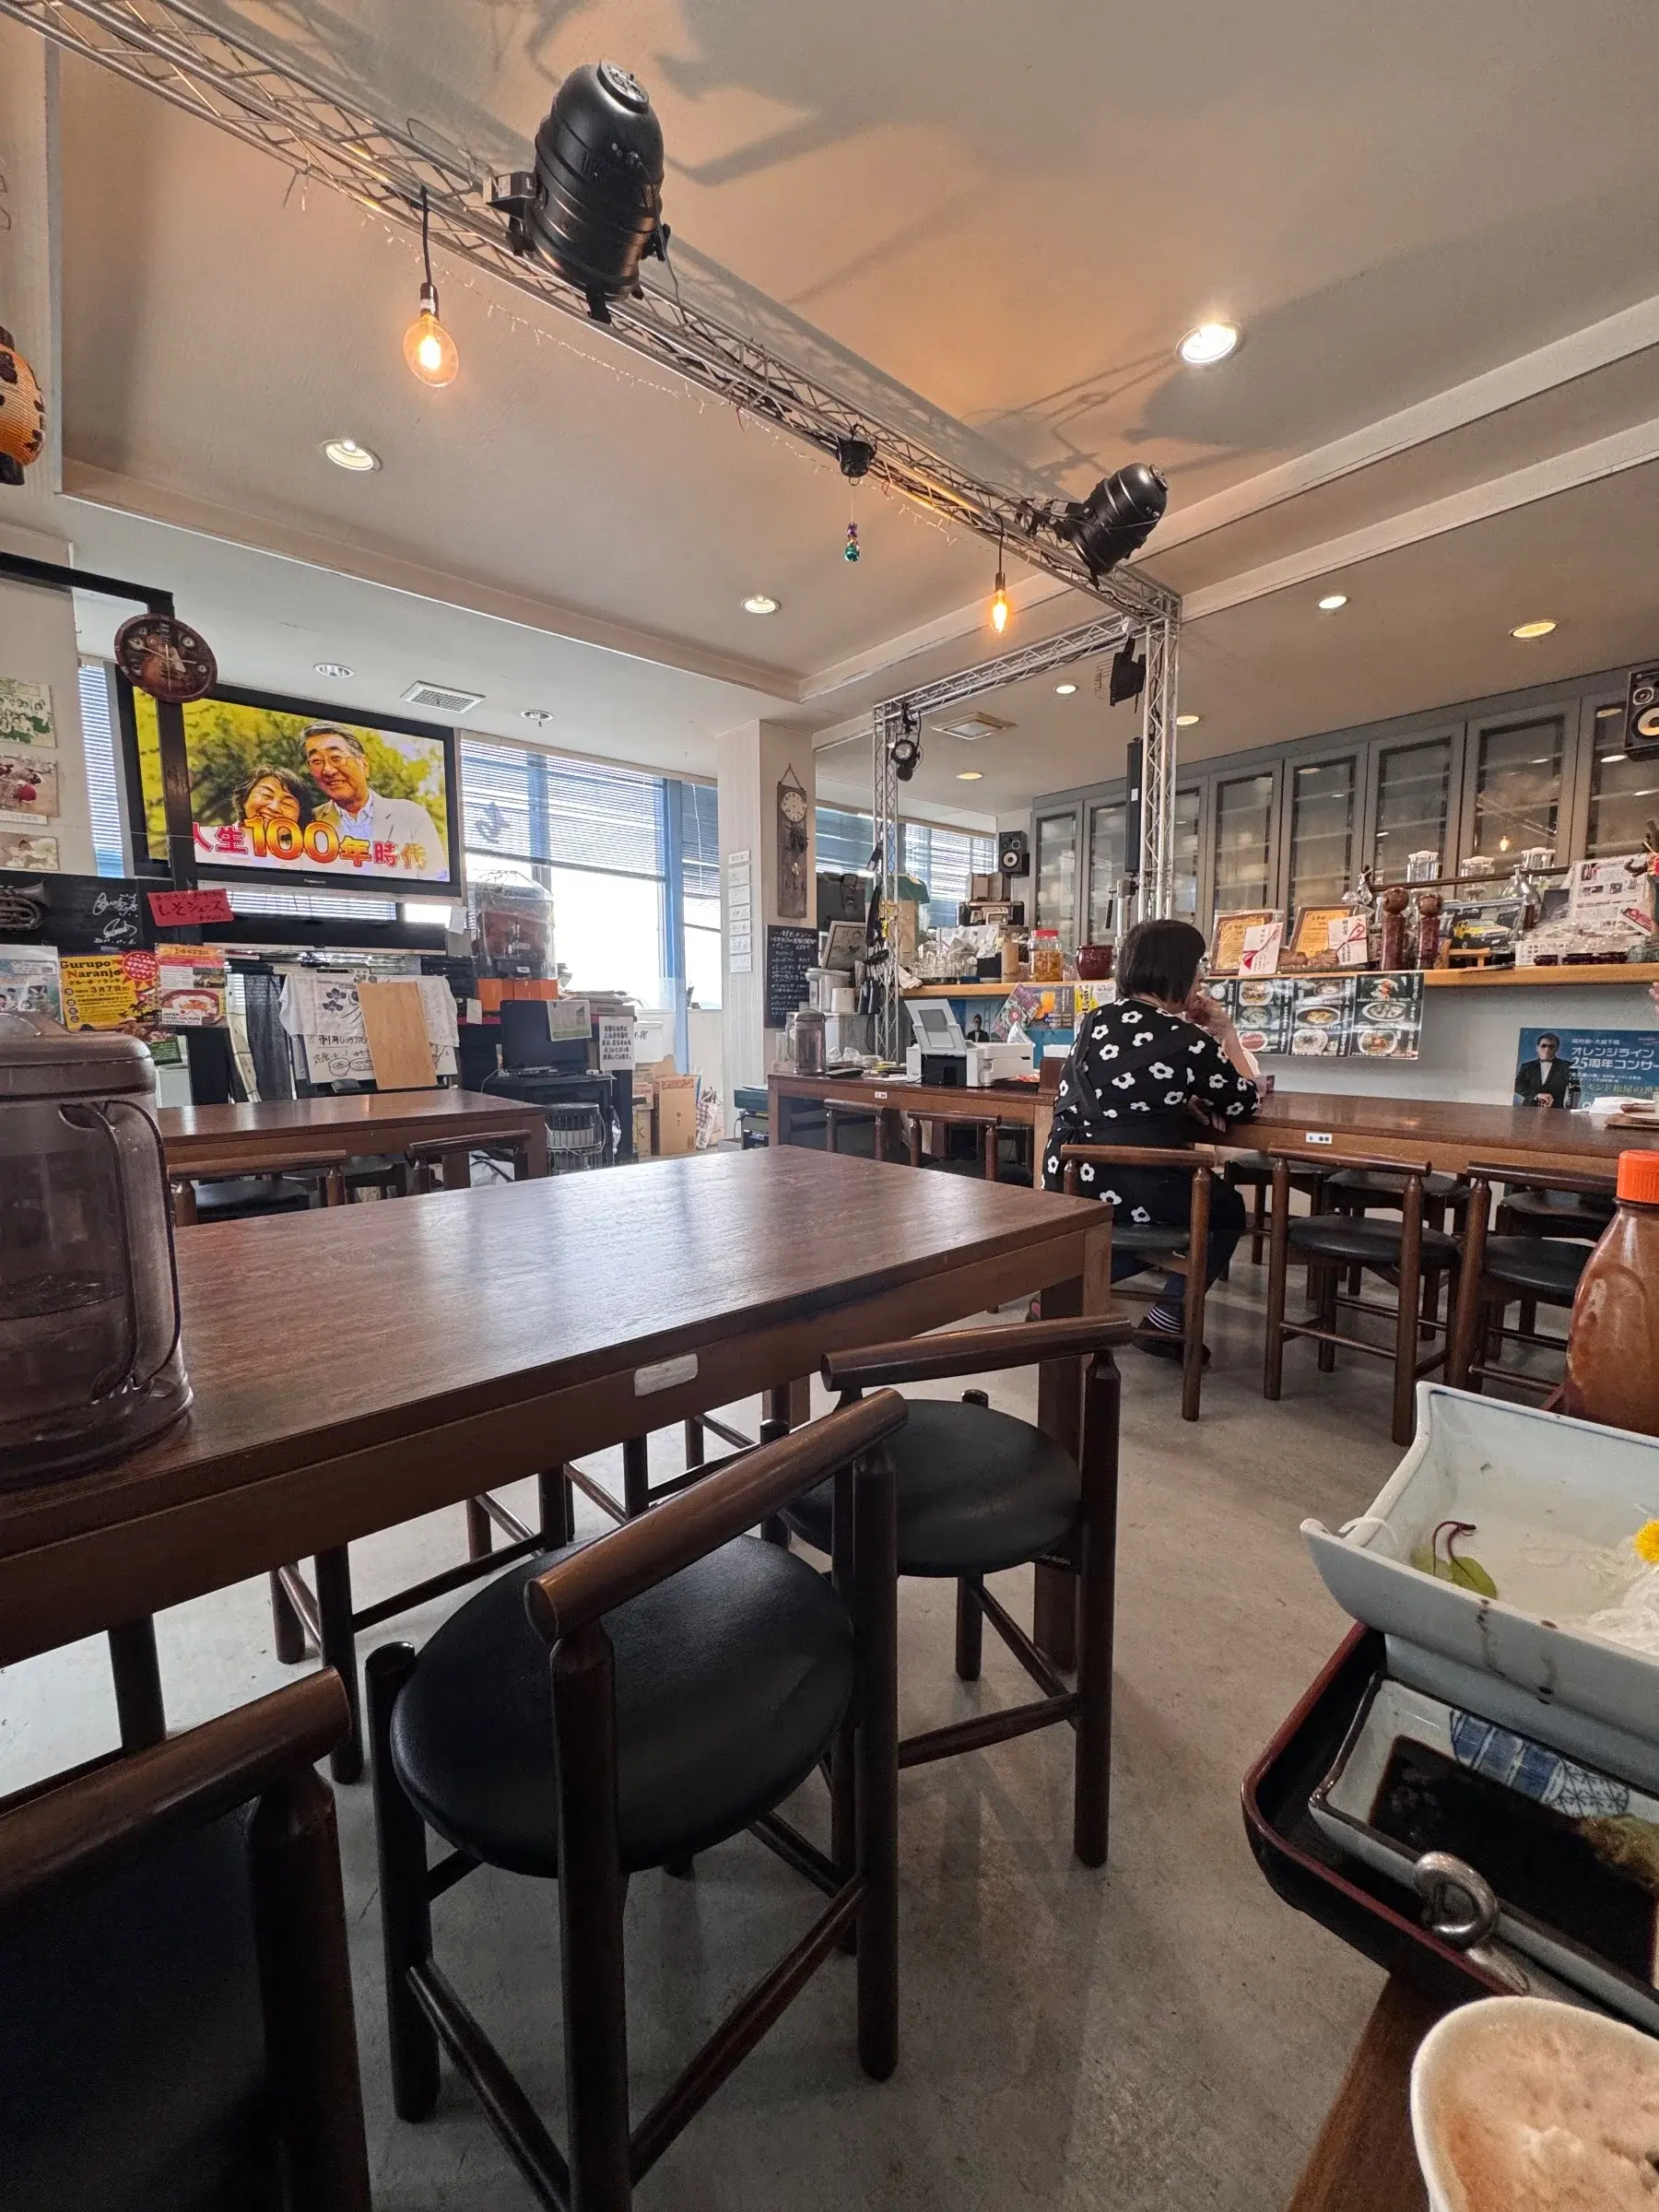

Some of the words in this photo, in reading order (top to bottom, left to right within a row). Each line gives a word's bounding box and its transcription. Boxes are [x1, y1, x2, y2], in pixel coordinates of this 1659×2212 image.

[60, 960, 111, 969] Gurupo
[66, 969, 122, 978] Naranjo
[1571, 1047, 1655, 1059] オレンジライン
